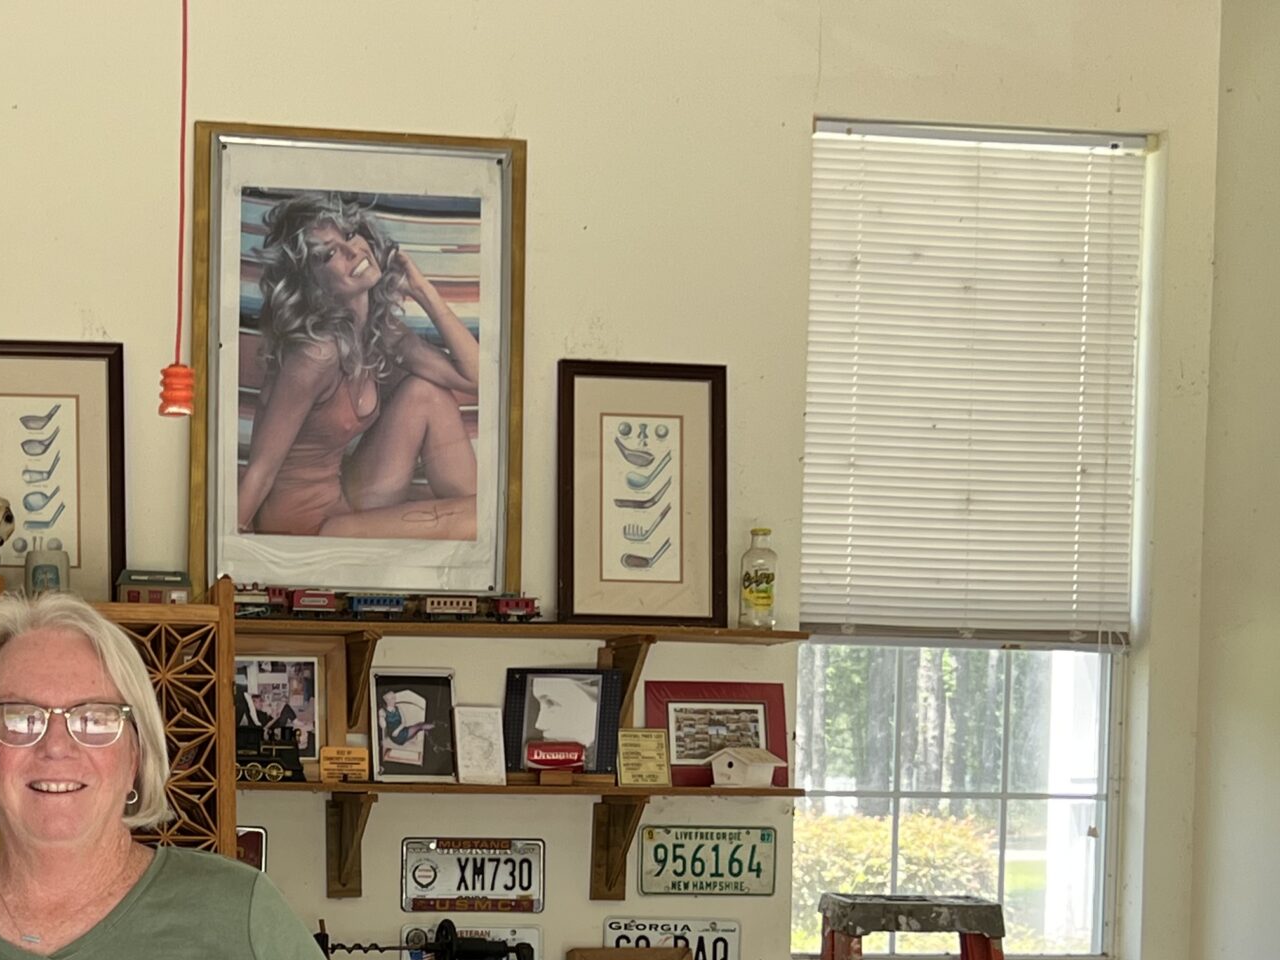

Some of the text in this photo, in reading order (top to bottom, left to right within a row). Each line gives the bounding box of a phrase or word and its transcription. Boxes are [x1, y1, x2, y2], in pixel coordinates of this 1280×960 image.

[675, 831, 693, 841] LIVE
[694, 831, 715, 841] FREE
[716, 832, 727, 841] OR
[728, 832, 742, 842] DIE
[438, 839, 511, 849] MUSTANG
[653, 843, 762, 879] 956164
[456, 857, 532, 892] XM730
[671, 881, 745, 892] NEW HAMPSHIRE
[608, 921, 692, 932] GEORGIA
